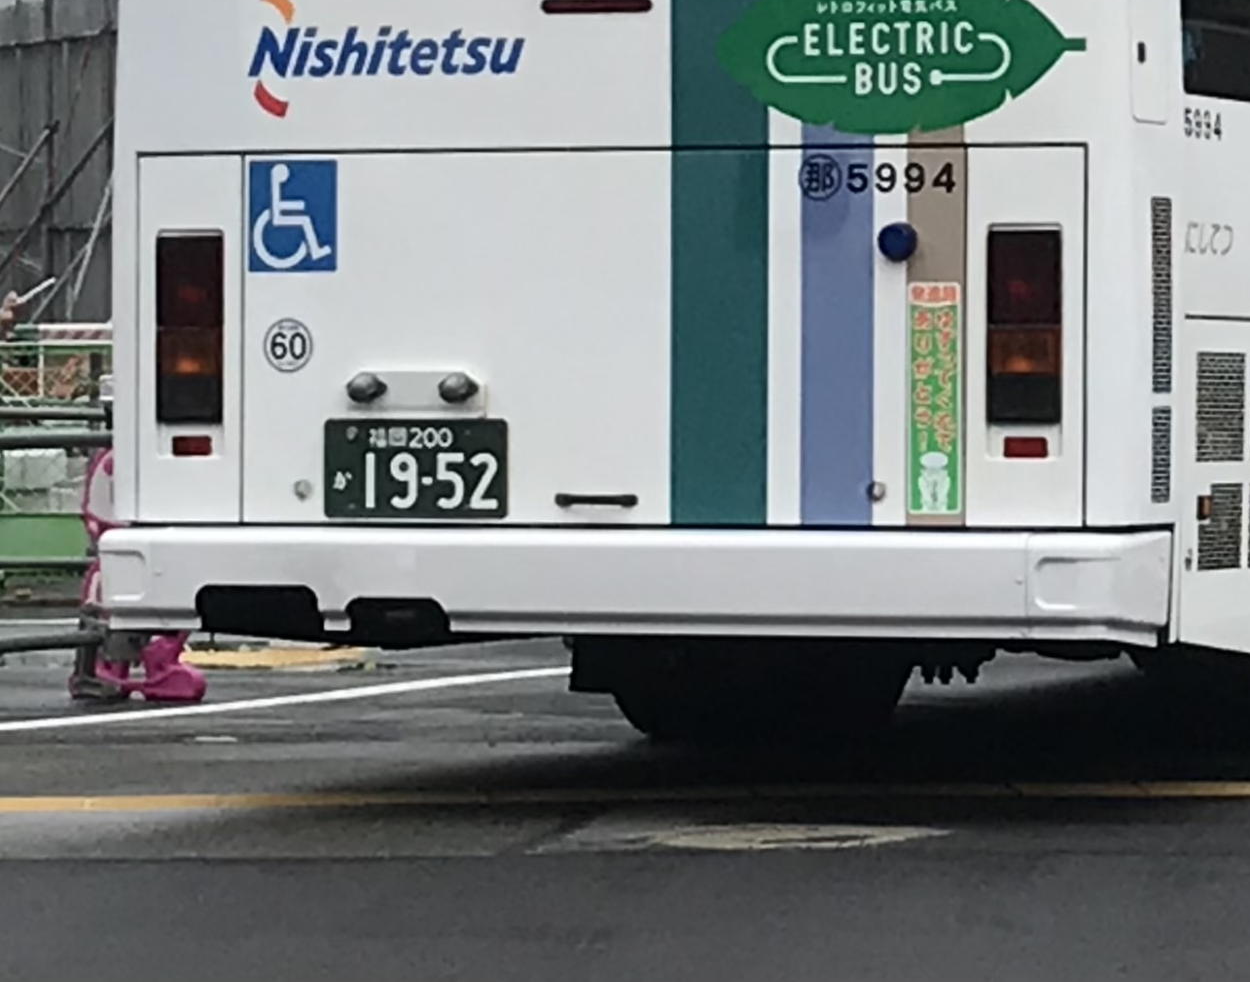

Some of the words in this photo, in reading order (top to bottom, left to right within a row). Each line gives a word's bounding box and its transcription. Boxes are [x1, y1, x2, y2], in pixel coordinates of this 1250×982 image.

[247, 24, 526, 79] Nishitetsu
[803, 20, 974, 57] ELECTRIC
[854, 61, 922, 96] BUS
[1184, 107, 1222, 141] 5994
[846, 161, 957, 194] 5994
[270, 331, 307, 360] 60
[365, 451, 499, 509] 19-52
